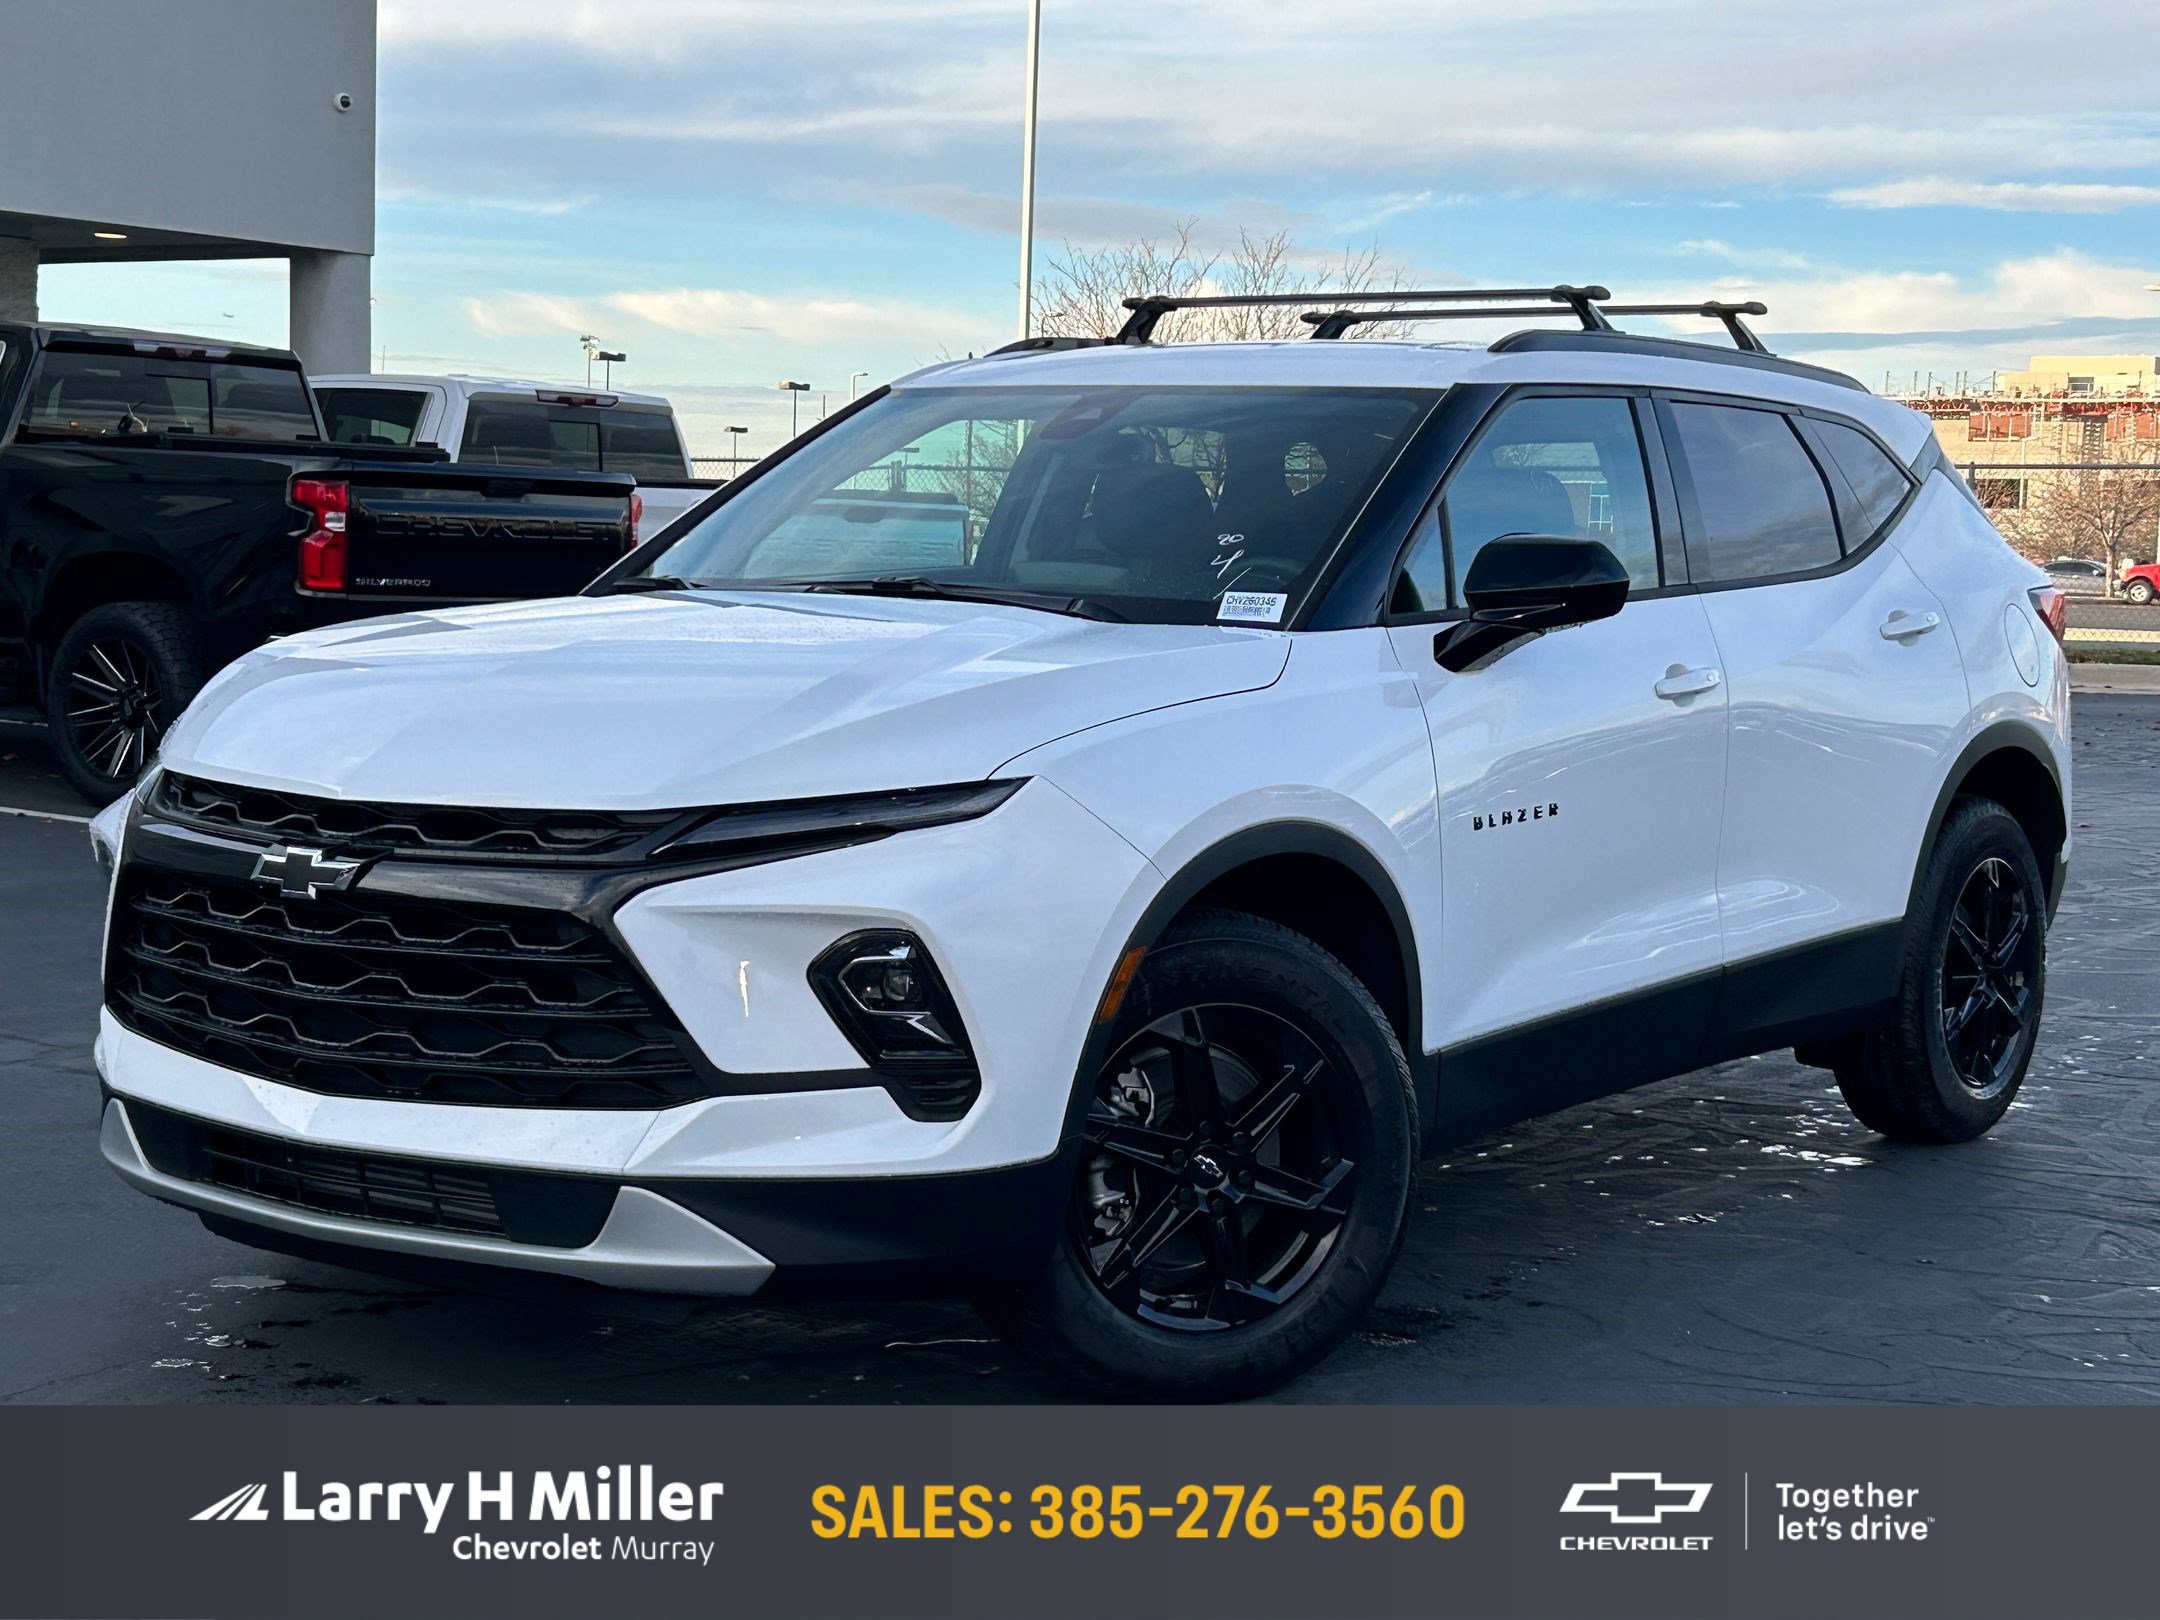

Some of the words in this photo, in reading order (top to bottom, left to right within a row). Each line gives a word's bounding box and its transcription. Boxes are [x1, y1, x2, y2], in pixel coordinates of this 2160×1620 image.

[376, 512, 617, 541] CHEVROLET
[355, 577, 431, 588] SILVERADO
[1473, 803, 1559, 831] BLAZER
